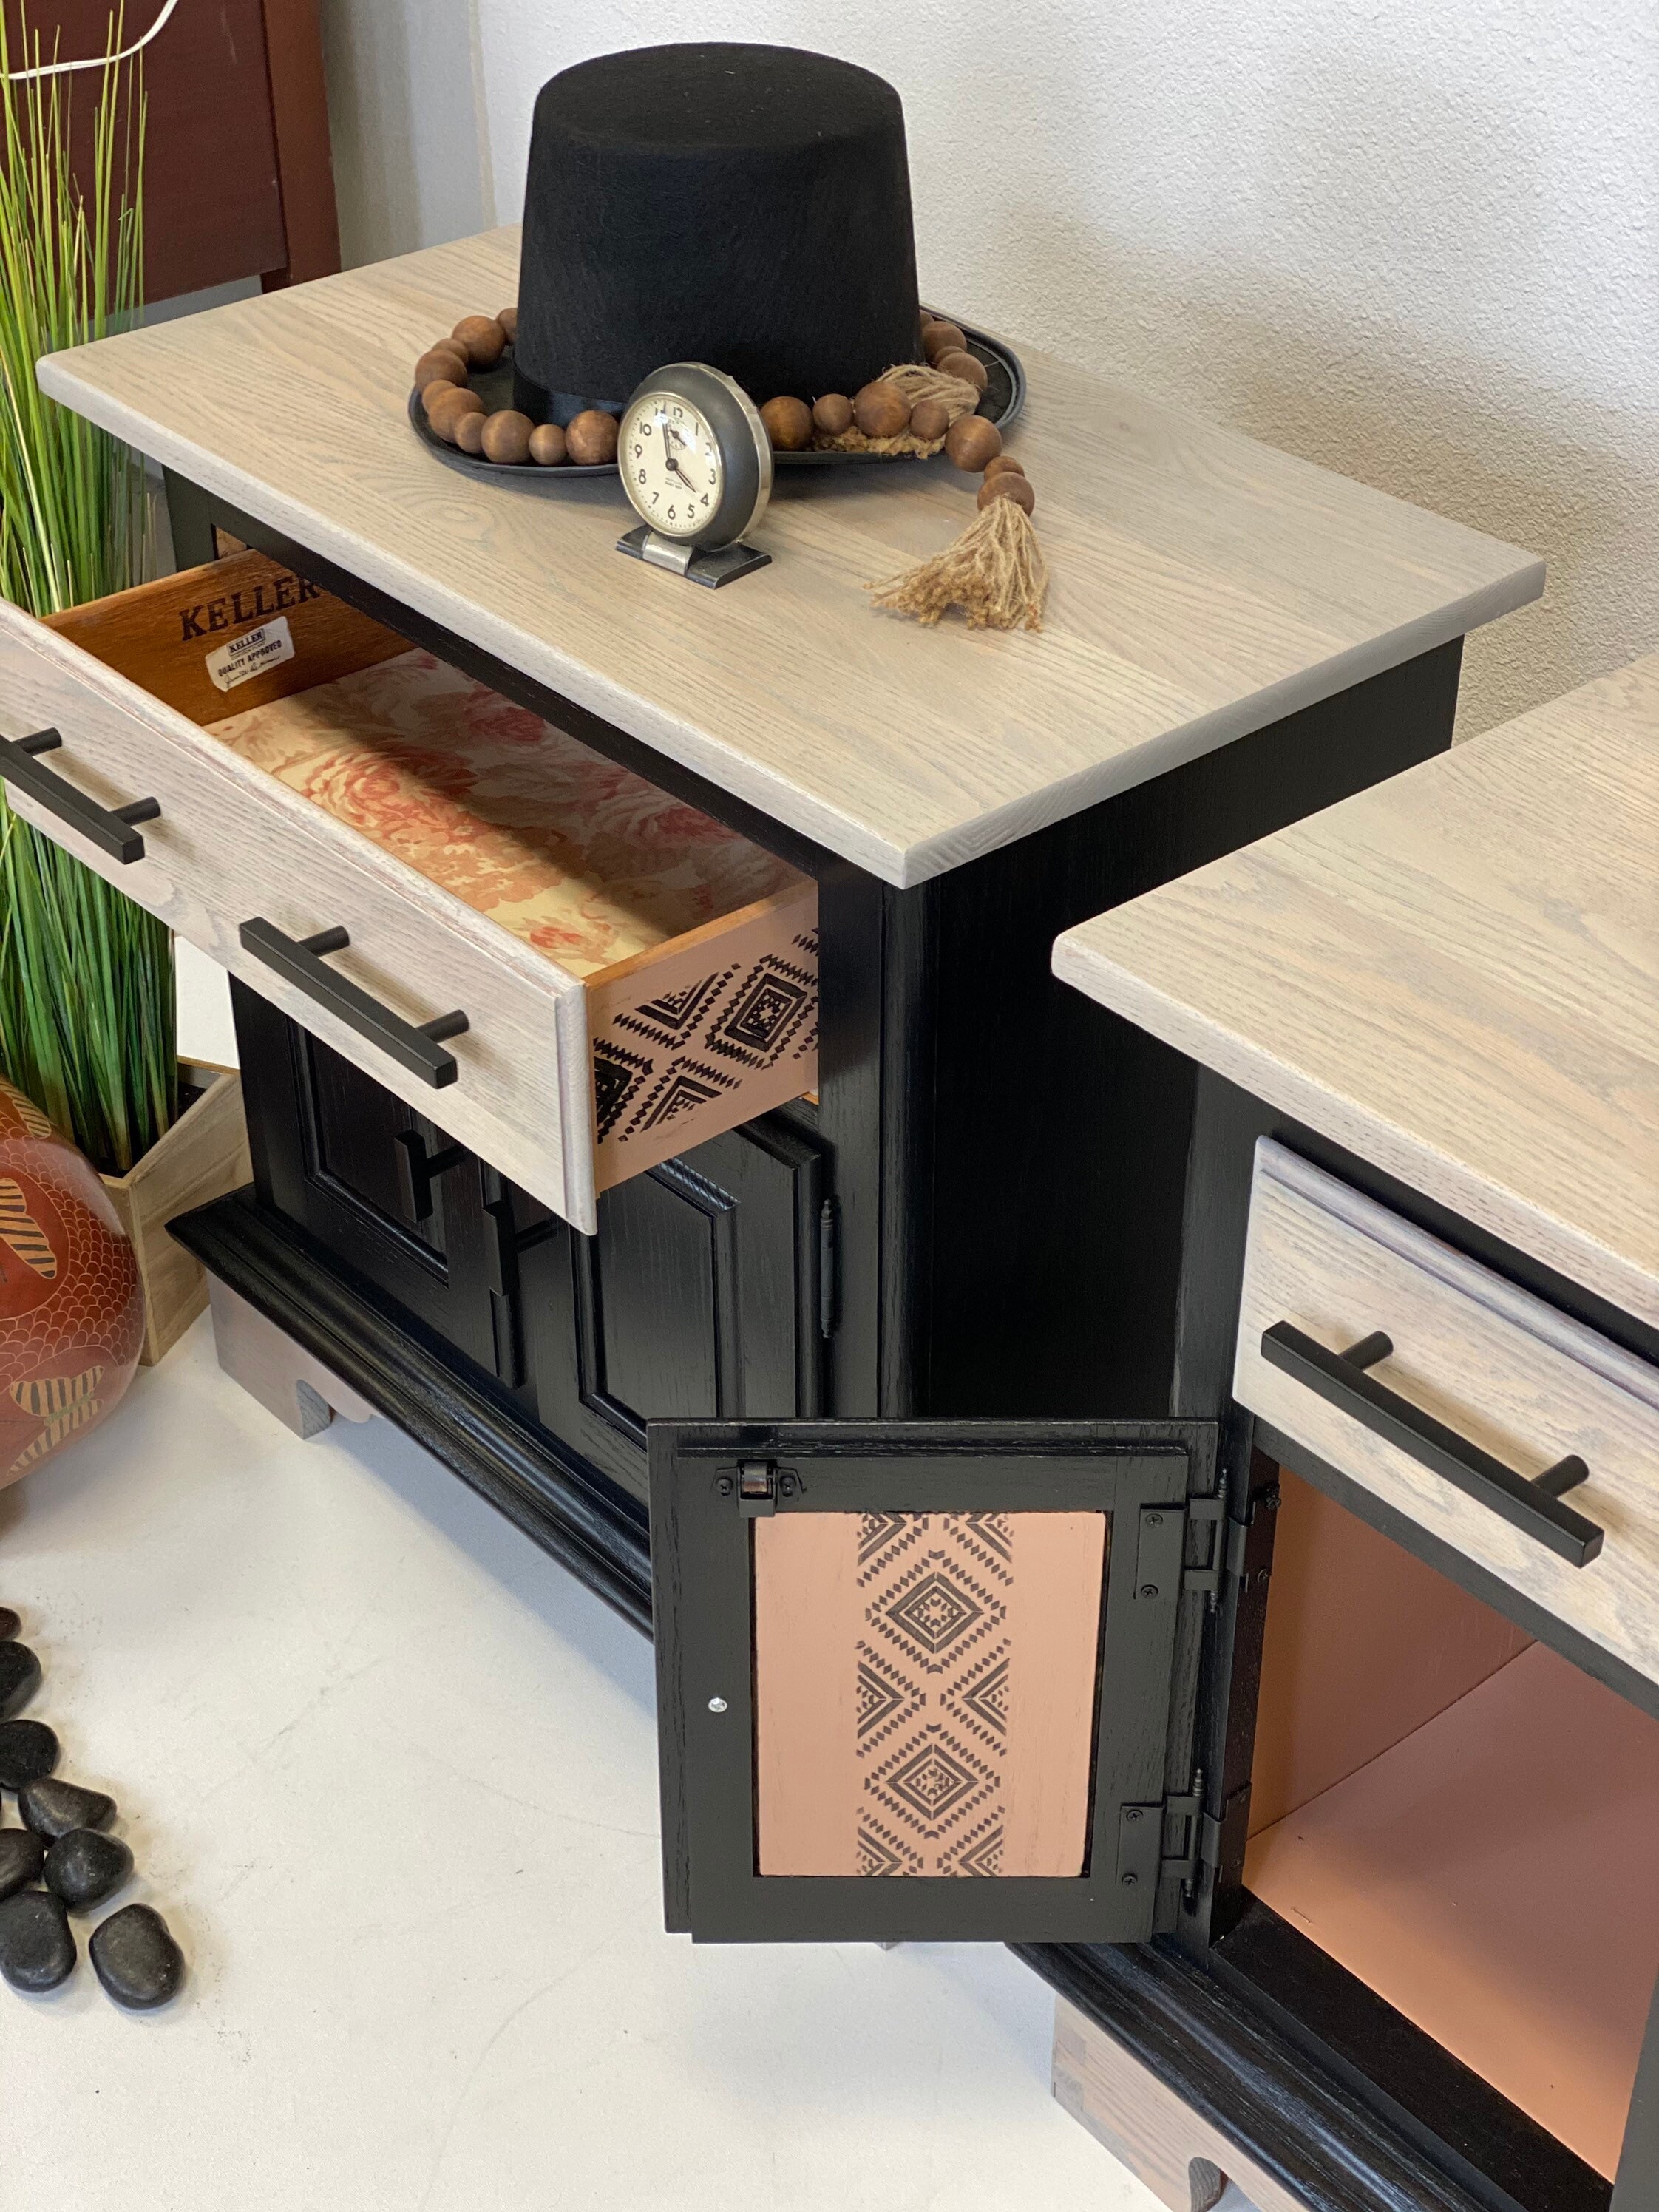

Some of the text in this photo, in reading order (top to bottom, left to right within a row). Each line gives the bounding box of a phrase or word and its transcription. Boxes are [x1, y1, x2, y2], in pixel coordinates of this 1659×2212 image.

[639, 421, 652, 437] 10
[695, 421, 699, 436] 1
[635, 444, 642, 458] 9
[638, 468, 647, 485] 8
[709, 469, 716, 484] 3
[652, 491, 660, 505] 7
[699, 492, 710, 507] 4
[667, 504, 676, 520] 6
[686, 503, 695, 519] 5
[179, 576, 320, 641] KELLER
[228, 631, 263, 654] KELLER
[217, 657, 245, 677] QUALITY
[247, 639, 282, 662] APPROVED
